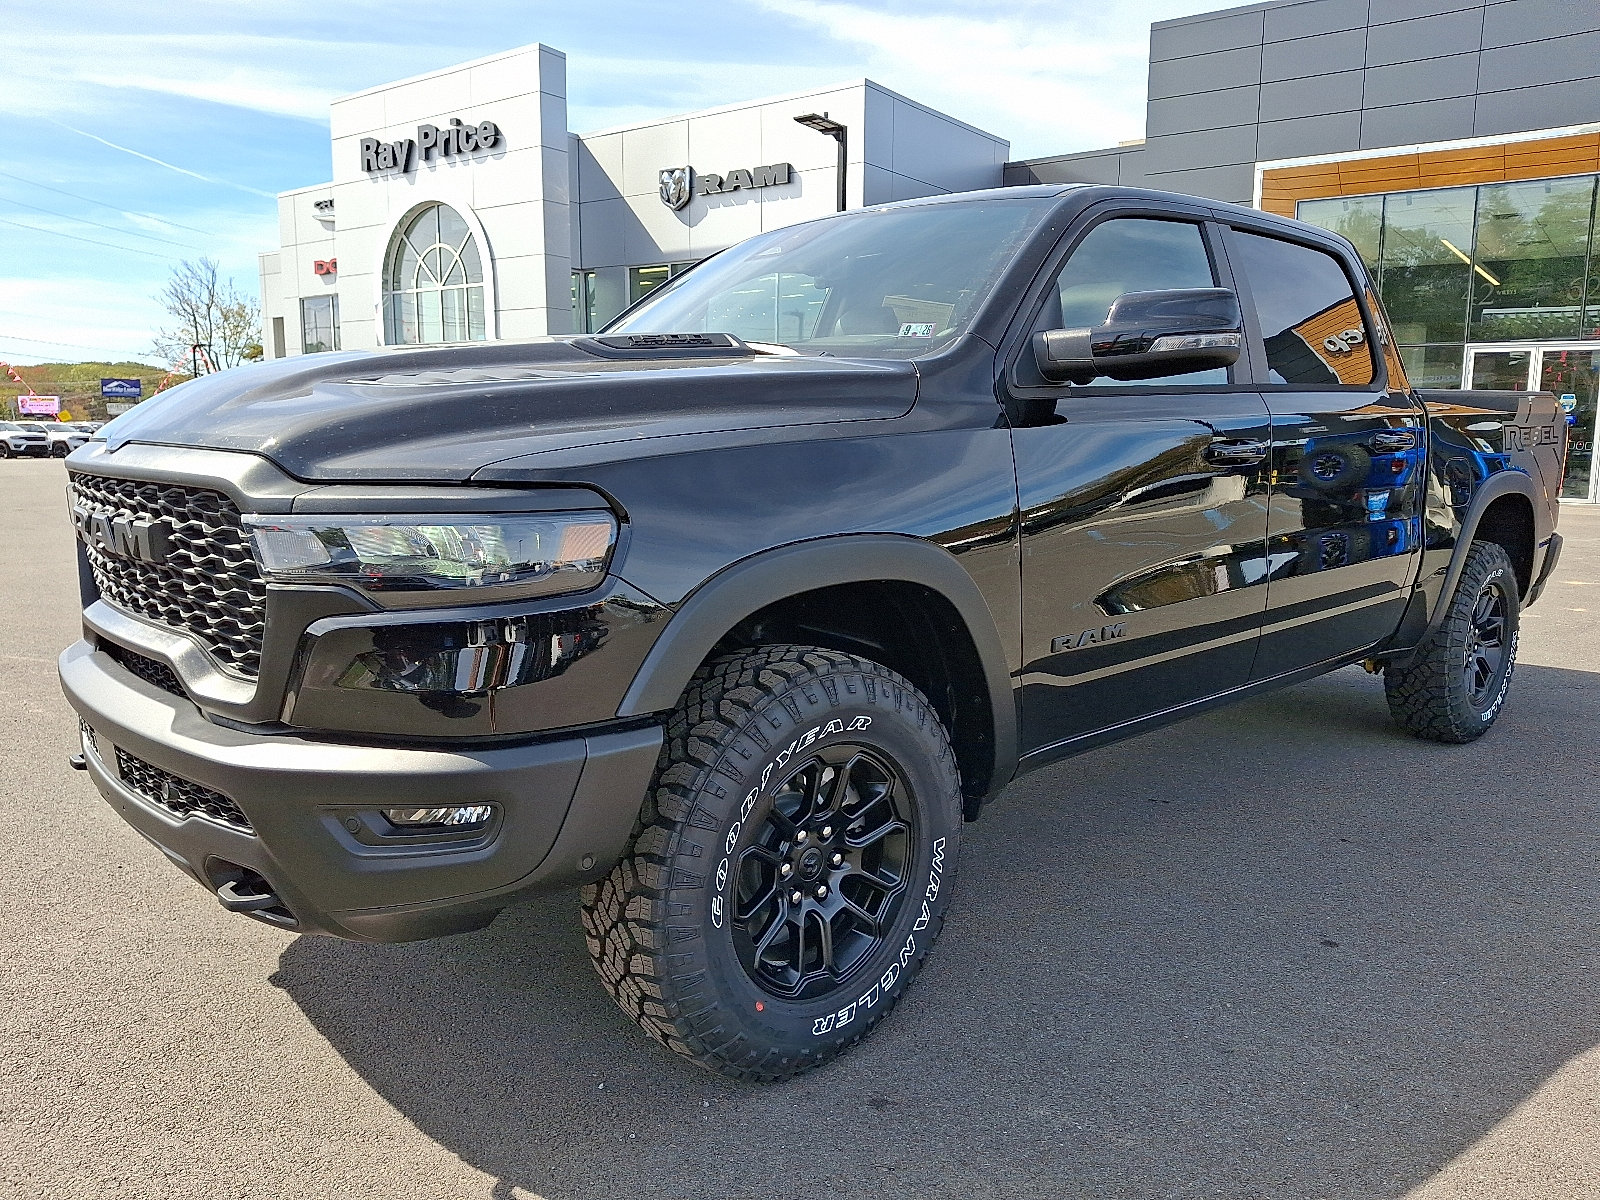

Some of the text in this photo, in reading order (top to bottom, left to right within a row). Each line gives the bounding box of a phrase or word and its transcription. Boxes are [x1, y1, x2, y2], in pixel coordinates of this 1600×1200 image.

[360, 117, 499, 174] Ray Price
[696, 163, 792, 196] RAM
[1502, 424, 1559, 452] REBEL
[73, 503, 160, 564] RAM
[1050, 622, 1127, 653] RAM
[711, 715, 873, 929] GOODYEAR
[811, 836, 946, 1037] WRANGLER
